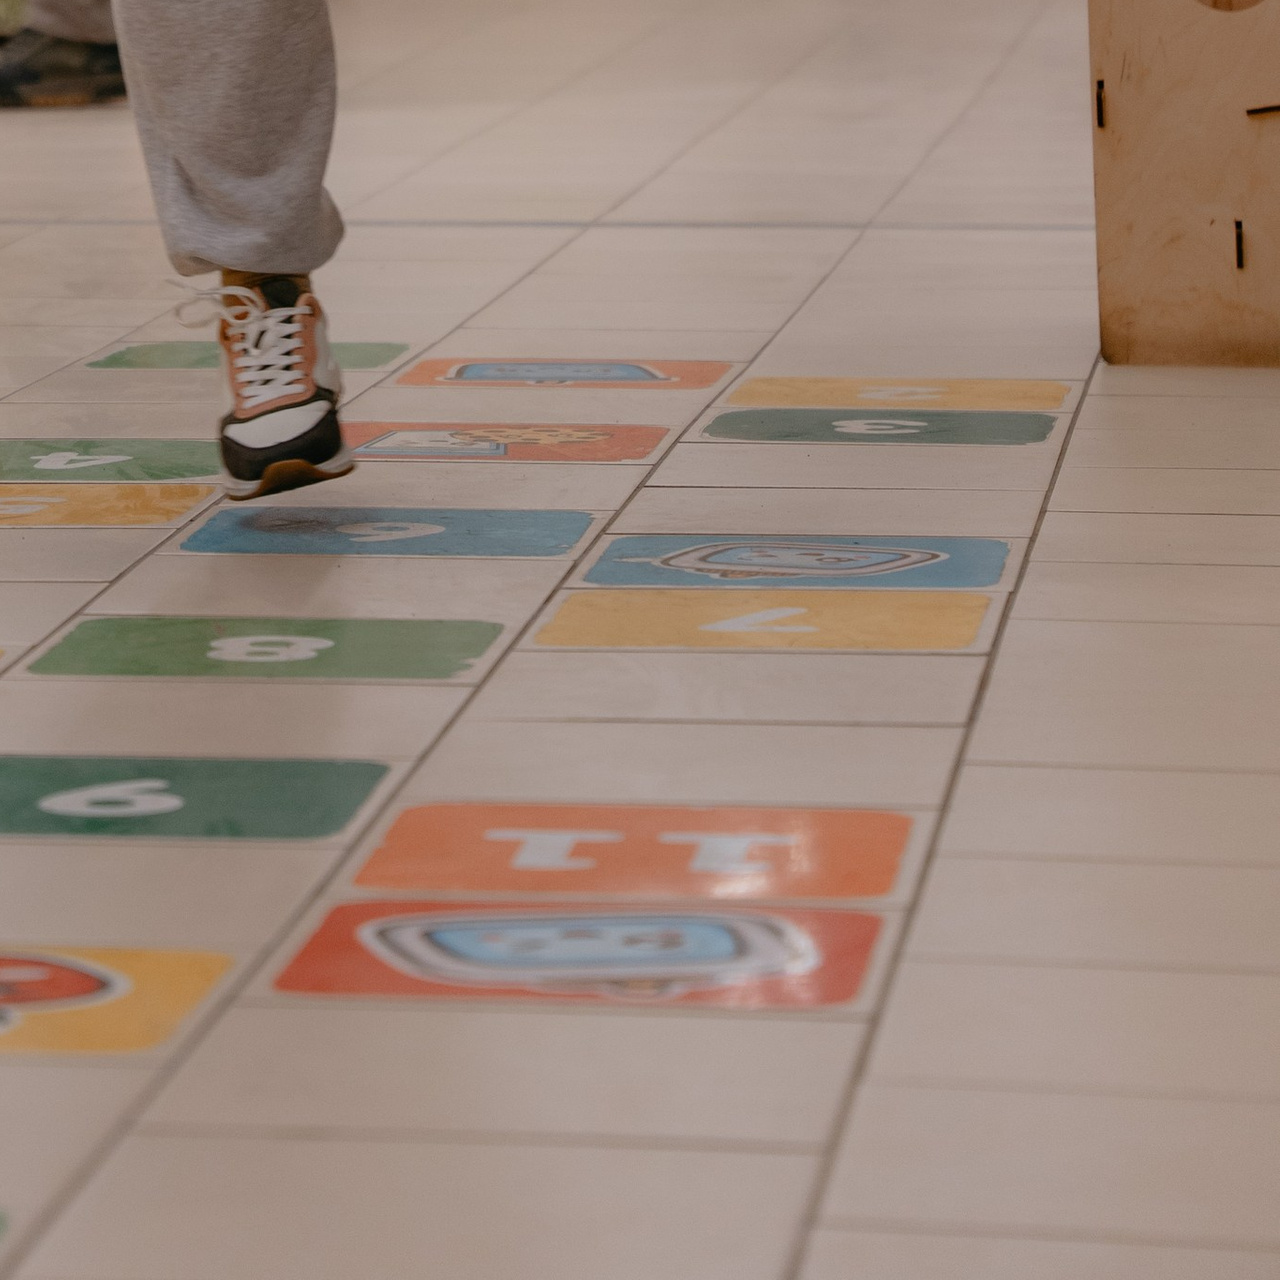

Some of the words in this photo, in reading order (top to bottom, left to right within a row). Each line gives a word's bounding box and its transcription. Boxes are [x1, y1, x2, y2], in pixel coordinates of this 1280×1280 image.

[831, 419, 928, 434] 3
[30, 451, 134, 470] 4
[697, 606, 820, 633] 7
[206, 635, 335, 662] 8
